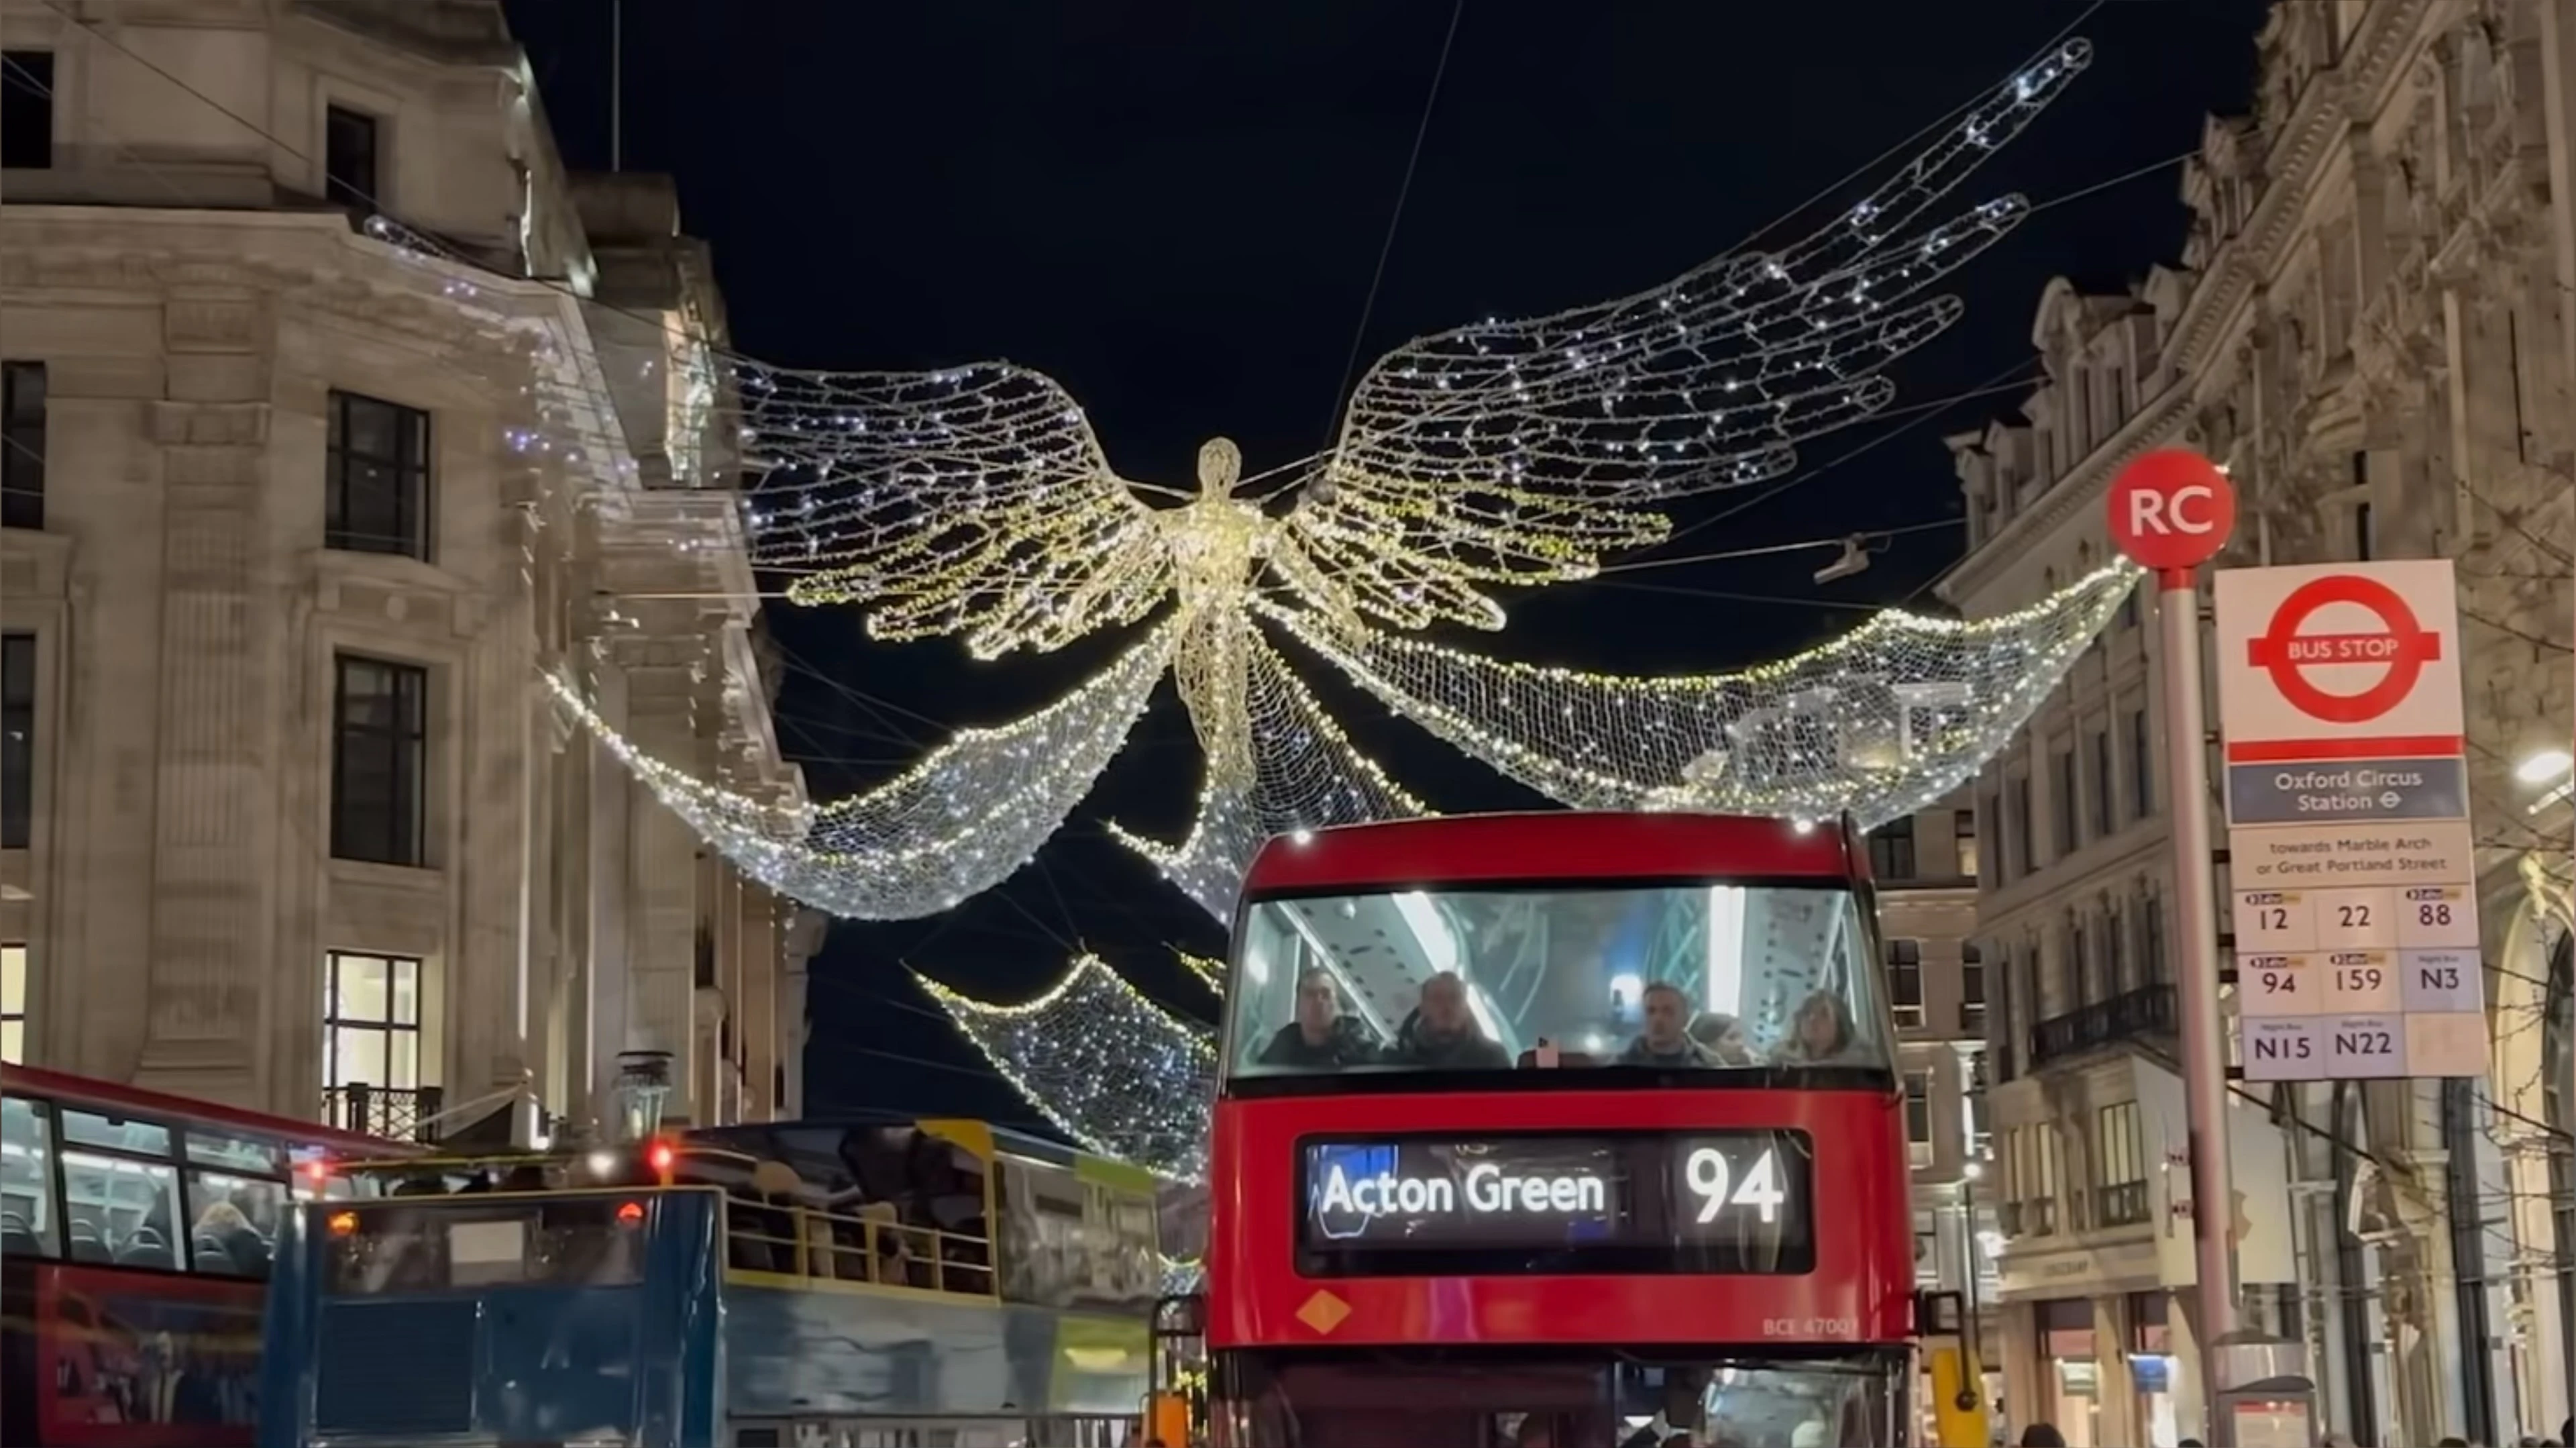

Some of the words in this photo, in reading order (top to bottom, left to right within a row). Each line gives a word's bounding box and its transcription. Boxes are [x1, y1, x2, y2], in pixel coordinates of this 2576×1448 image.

[2129, 486, 2214, 536] RC
[2288, 639, 2332, 660] BUS
[2339, 637, 2398, 658] STOP
[2275, 770, 2349, 790] Oxford
[2356, 770, 2424, 788] Circus
[2298, 793, 2373, 812] Station
[2269, 841, 2331, 854] towards
[2337, 839, 2390, 851] Marble
[2395, 837, 2432, 851] Arch
[2255, 864, 2271, 875] or
[2277, 860, 2322, 874] Great
[2326, 858, 2393, 872] Portland
[2398, 857, 2447, 872] Street
[2259, 908, 2289, 930] 12
[2337, 905, 2371, 927] 22
[2419, 904, 2452, 926] 88
[2262, 972, 2296, 994] 94
[2336, 969, 2382, 991] 159
[2420, 968, 2460, 990] N3
[2255, 1037, 2311, 1059] N15
[2335, 1031, 2393, 1055] N22
[1322, 1163, 1454, 1213] Acton
[1466, 1163, 1605, 1213] Green
[1686, 1147, 1784, 1224] 94
